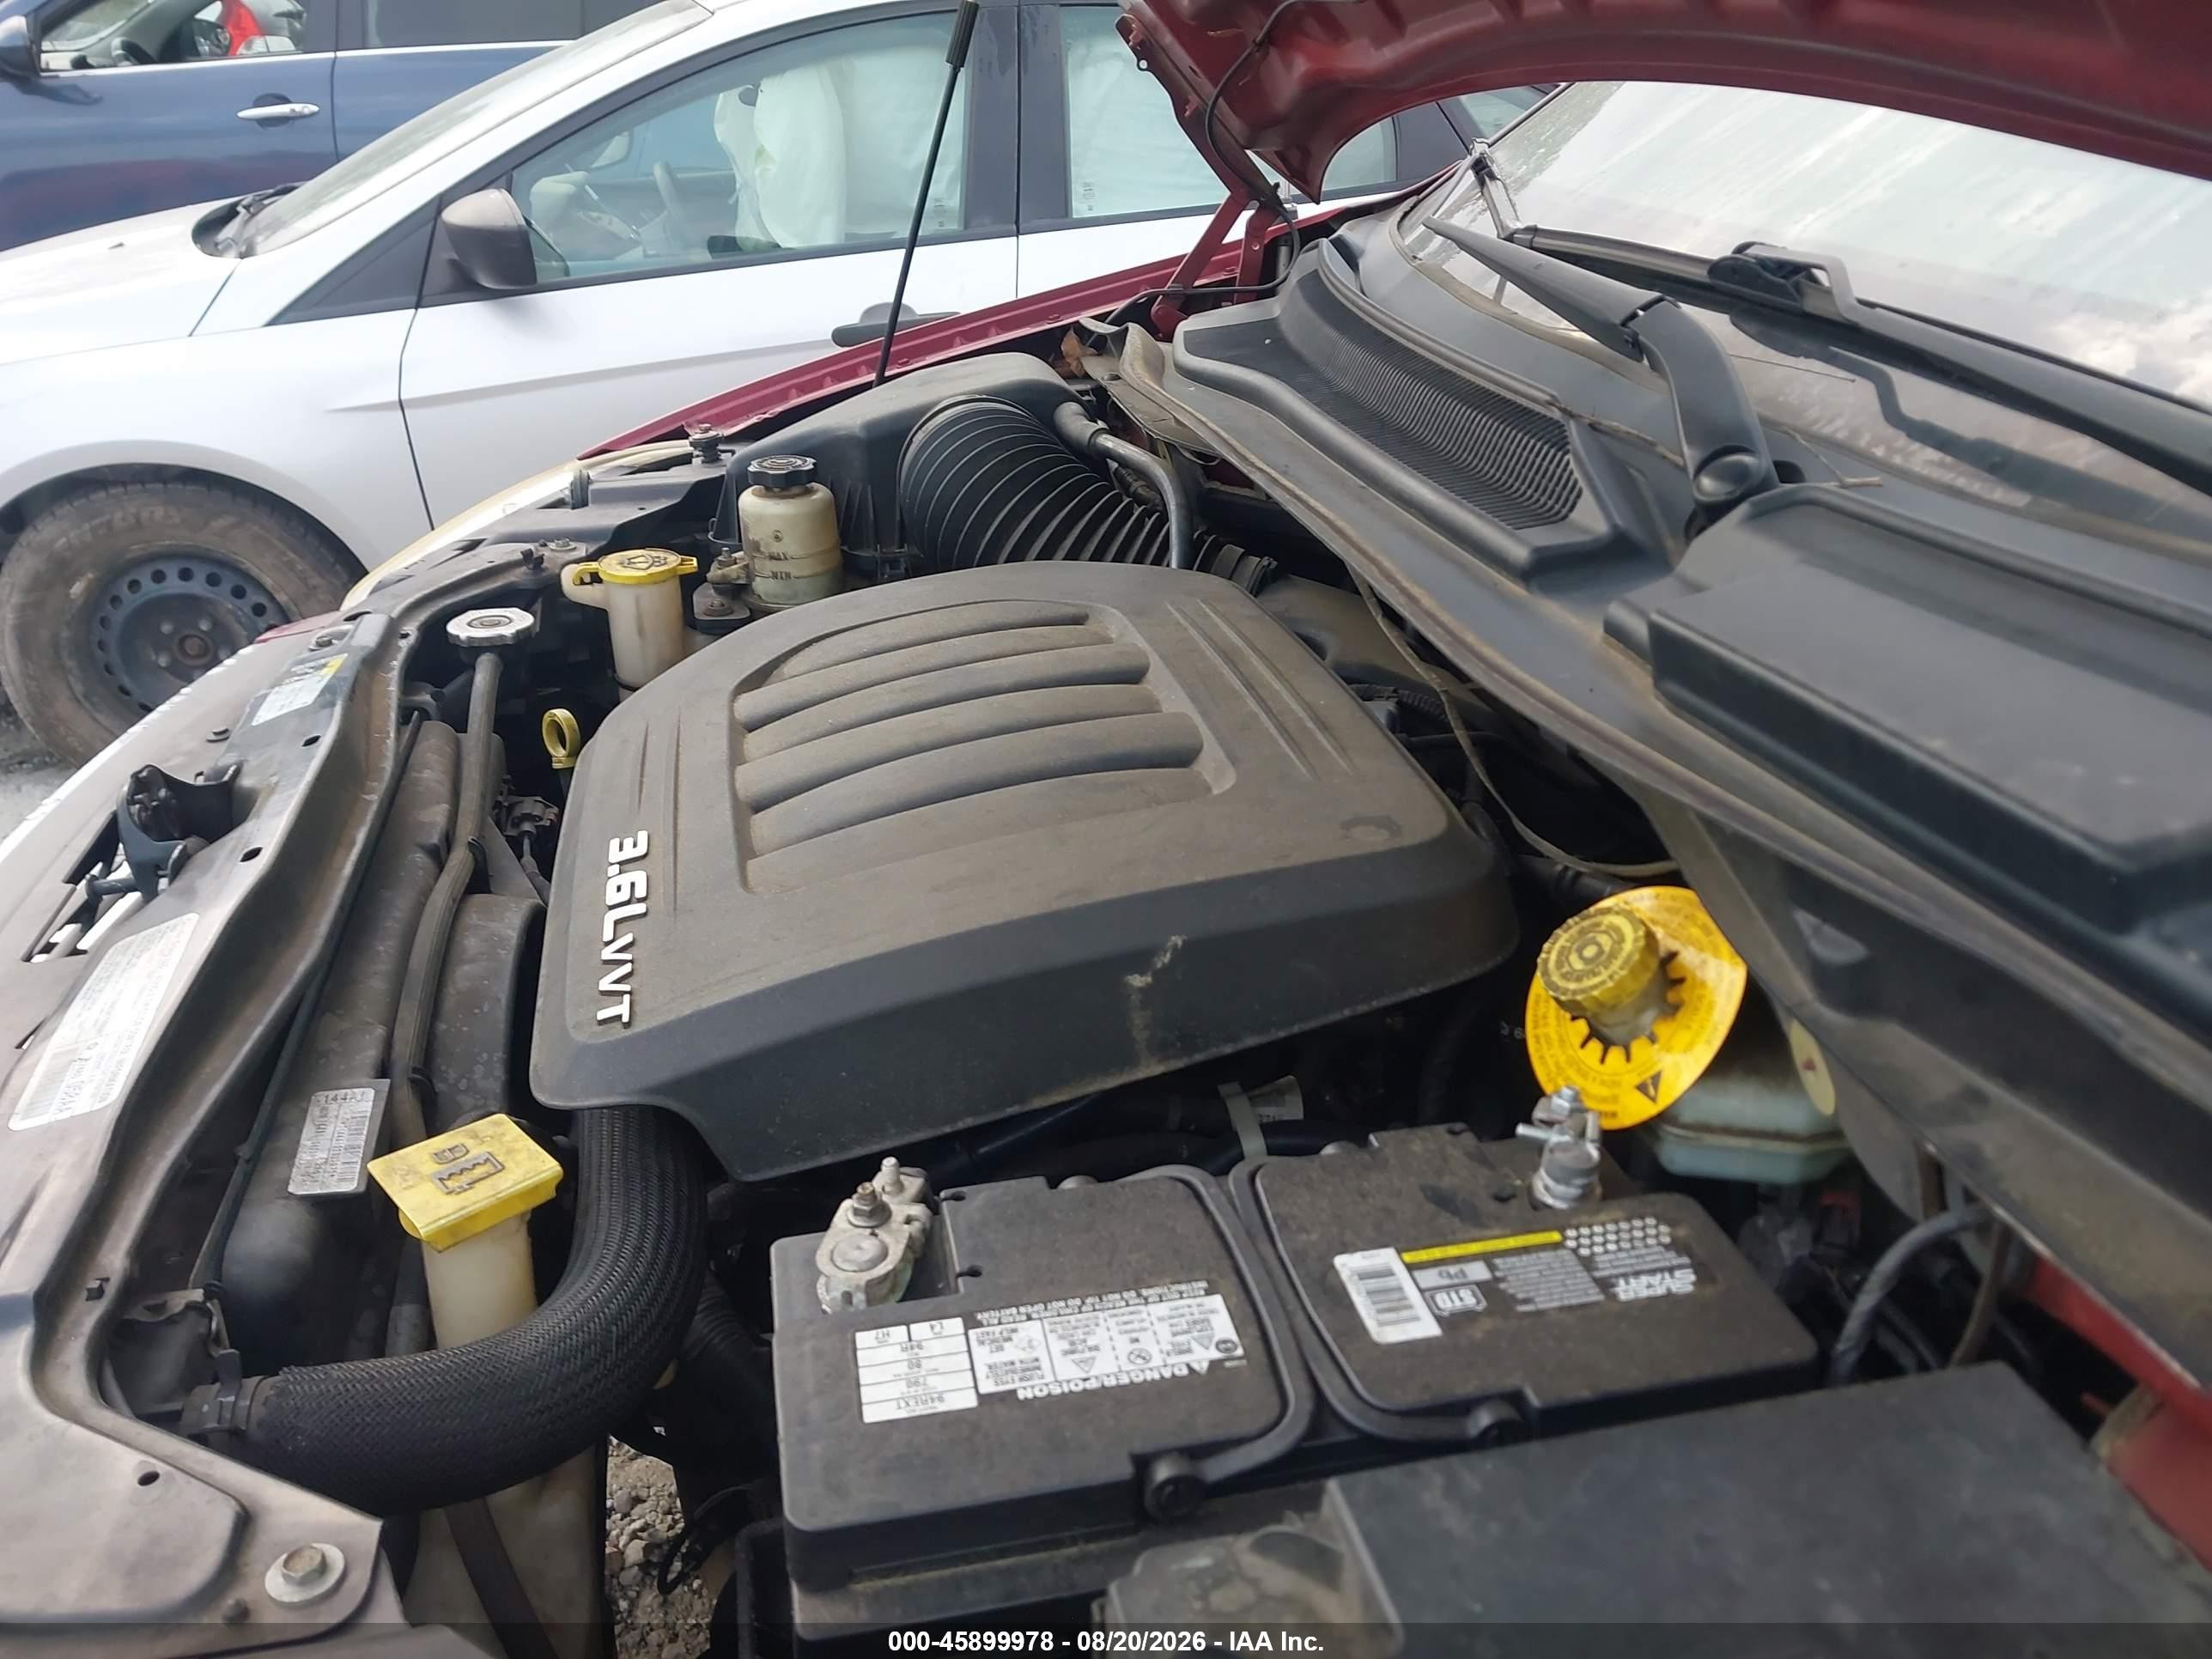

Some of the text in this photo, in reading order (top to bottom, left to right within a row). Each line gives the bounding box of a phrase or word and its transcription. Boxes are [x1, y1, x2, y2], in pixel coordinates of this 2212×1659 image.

[1437, 1267, 1468, 1281] Pb
[1615, 1268, 1697, 1291] START
[1617, 1281, 1694, 1303] SUPER
[1016, 1363, 1188, 1401] DANGER/POISON
[896, 1394, 945, 1410] 94REXT
